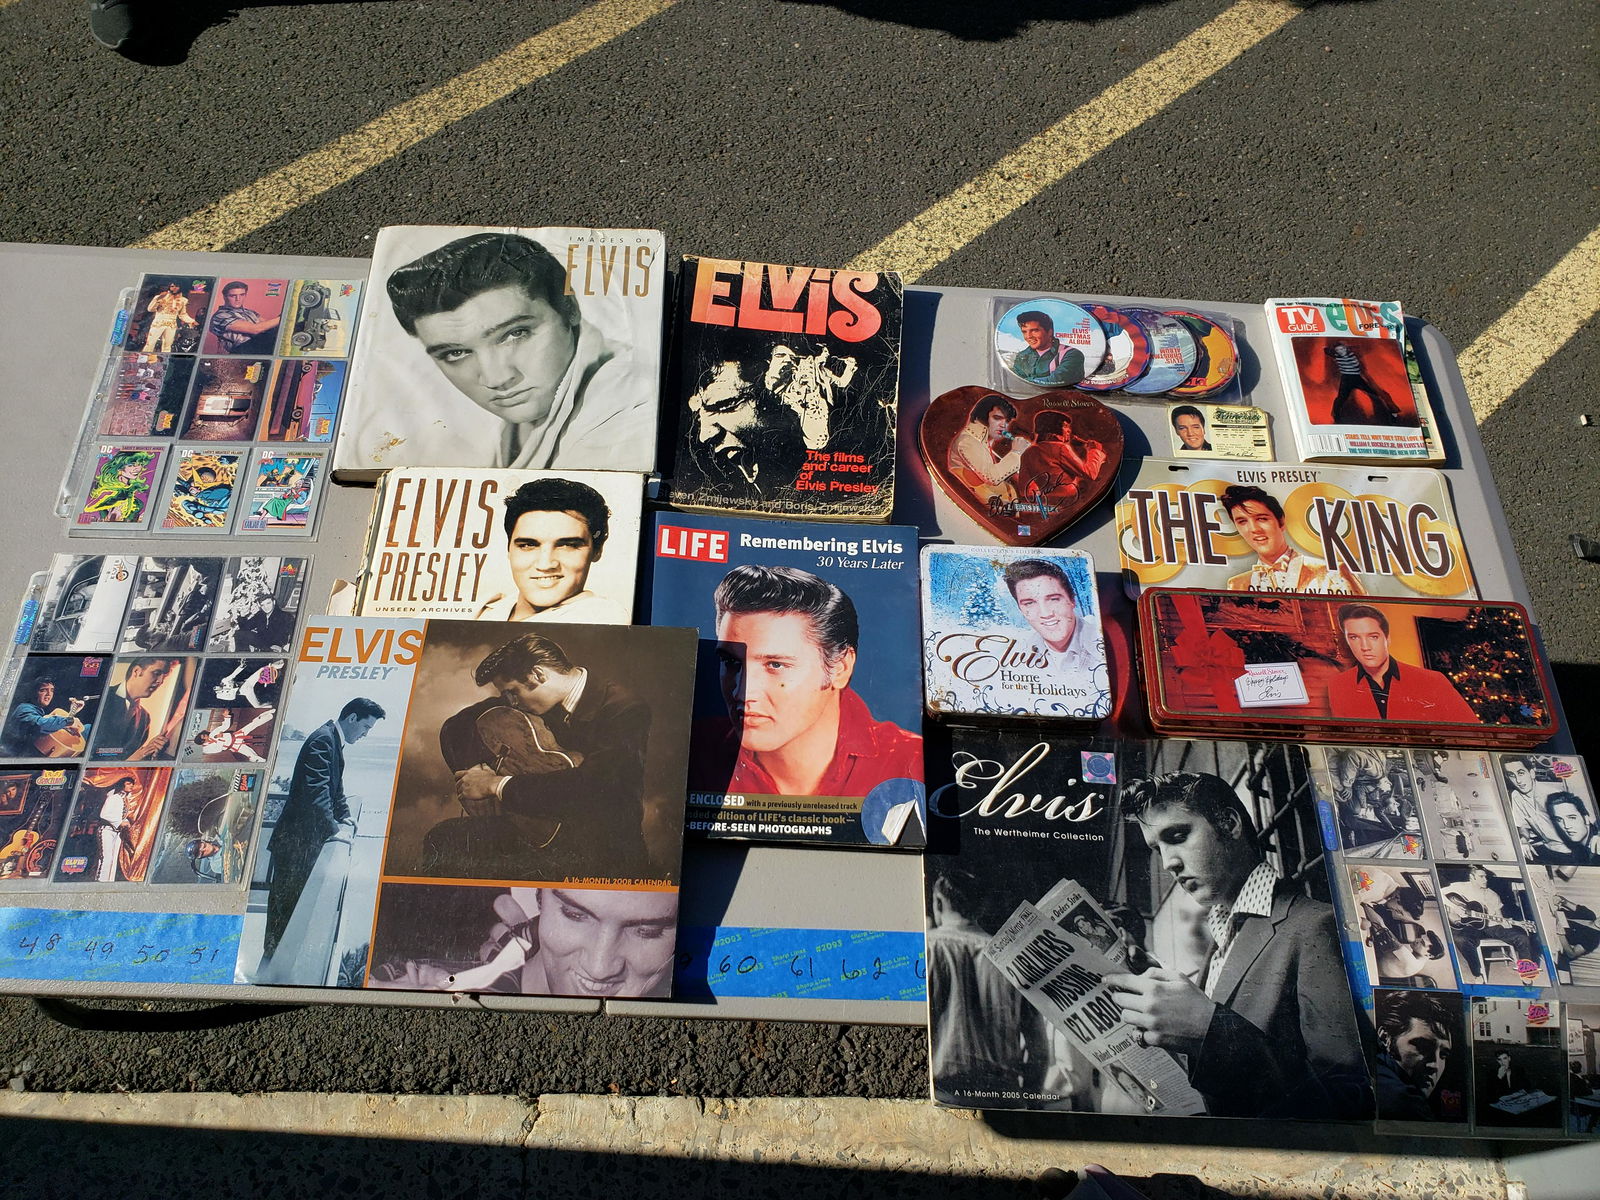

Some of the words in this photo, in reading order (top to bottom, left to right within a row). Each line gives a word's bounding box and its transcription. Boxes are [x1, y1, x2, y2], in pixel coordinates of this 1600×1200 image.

[569, 236, 624, 244] IMAGES
[563, 243, 651, 297] ELVIS
[690, 257, 882, 343] ELVIS
[1281, 307, 1315, 324] TV
[1287, 323, 1318, 332] GUIDE
[1055, 332, 1091, 340] CHRISTMAS
[1042, 398, 1069, 407] Russell
[100, 445, 114, 454] DC
[181, 450, 194, 458] DC
[262, 451, 274, 459] DC
[806, 450, 831, 462] The
[833, 452, 864, 464] films
[802, 461, 826, 471] and
[830, 464, 873, 473] career
[799, 471, 814, 480] of
[1237, 470, 1267, 483] ELVIS
[795, 480, 826, 491] Elvis
[830, 481, 880, 496] Presley
[699, 492, 759, 506] Zmijewsky
[762, 500, 782, 509] and
[786, 502, 814, 511] Boris
[385, 478, 498, 549] ELVIS
[1128, 489, 1228, 566] THE
[660, 528, 725, 560] LIFE
[740, 533, 858, 556] Remembering
[862, 539, 903, 555] Elvis
[1314, 497, 1451, 577] KING
[816, 556, 834, 568] 30
[836, 556, 868, 570] Years
[871, 558, 905, 570] Later
[373, 552, 488, 602] PRESLEY
[298, 626, 424, 666] ELVIS
[936, 633, 1050, 688] Elvis
[316, 665, 393, 680] PRESLEY
[1000, 670, 1040, 683] Home
[1001, 682, 1014, 690] for
[1015, 682, 1028, 690] the
[1030, 683, 1087, 698] Holidays
[1258, 686, 1282, 701] Elvis
[928, 742, 1104, 822] Elvis
[689, 794, 745, 806] ENCLOSED
[746, 800, 760, 808] with
[768, 800, 802, 814] previously
[803, 801, 839, 812] unreleased
[840, 802, 858, 810] track
[712, 810, 745, 822] edition
[746, 812, 758, 822] of
[758, 813, 787, 824] LIFE's
[788, 814, 821, 824] classic
[758, 824, 832, 836] PHOTOGRAPHS
[974, 826, 990, 836] The
[994, 828, 1050, 840] Wertheimer
[1052, 831, 1104, 842] Collection
[571, 877, 611, 885] 16-MONTH
[613, 878, 632, 886] 2008
[634, 879, 672, 887] CALENDAR
[1053, 903, 1071, 920] Orders
[816, 939, 843, 953] #2093
[19, 933, 62, 956] 48
[84, 940, 115, 961] 49
[134, 944, 171, 965] 50
[188, 946, 221, 965] 51
[720, 955, 757, 974] 60
[790, 955, 814, 979] 61
[842, 957, 887, 981] 62
[772, 952, 790, 962] Sharp
[1014, 928, 1076, 990] AIRLINERS
[1006, 965, 1025, 988] 2
[1063, 1012, 1097, 1045] 127
[1110, 1037, 1131, 1057] Storms
[963, 1090, 1000, 1098] 16-Month
[1022, 1092, 1060, 1101] Calendar
